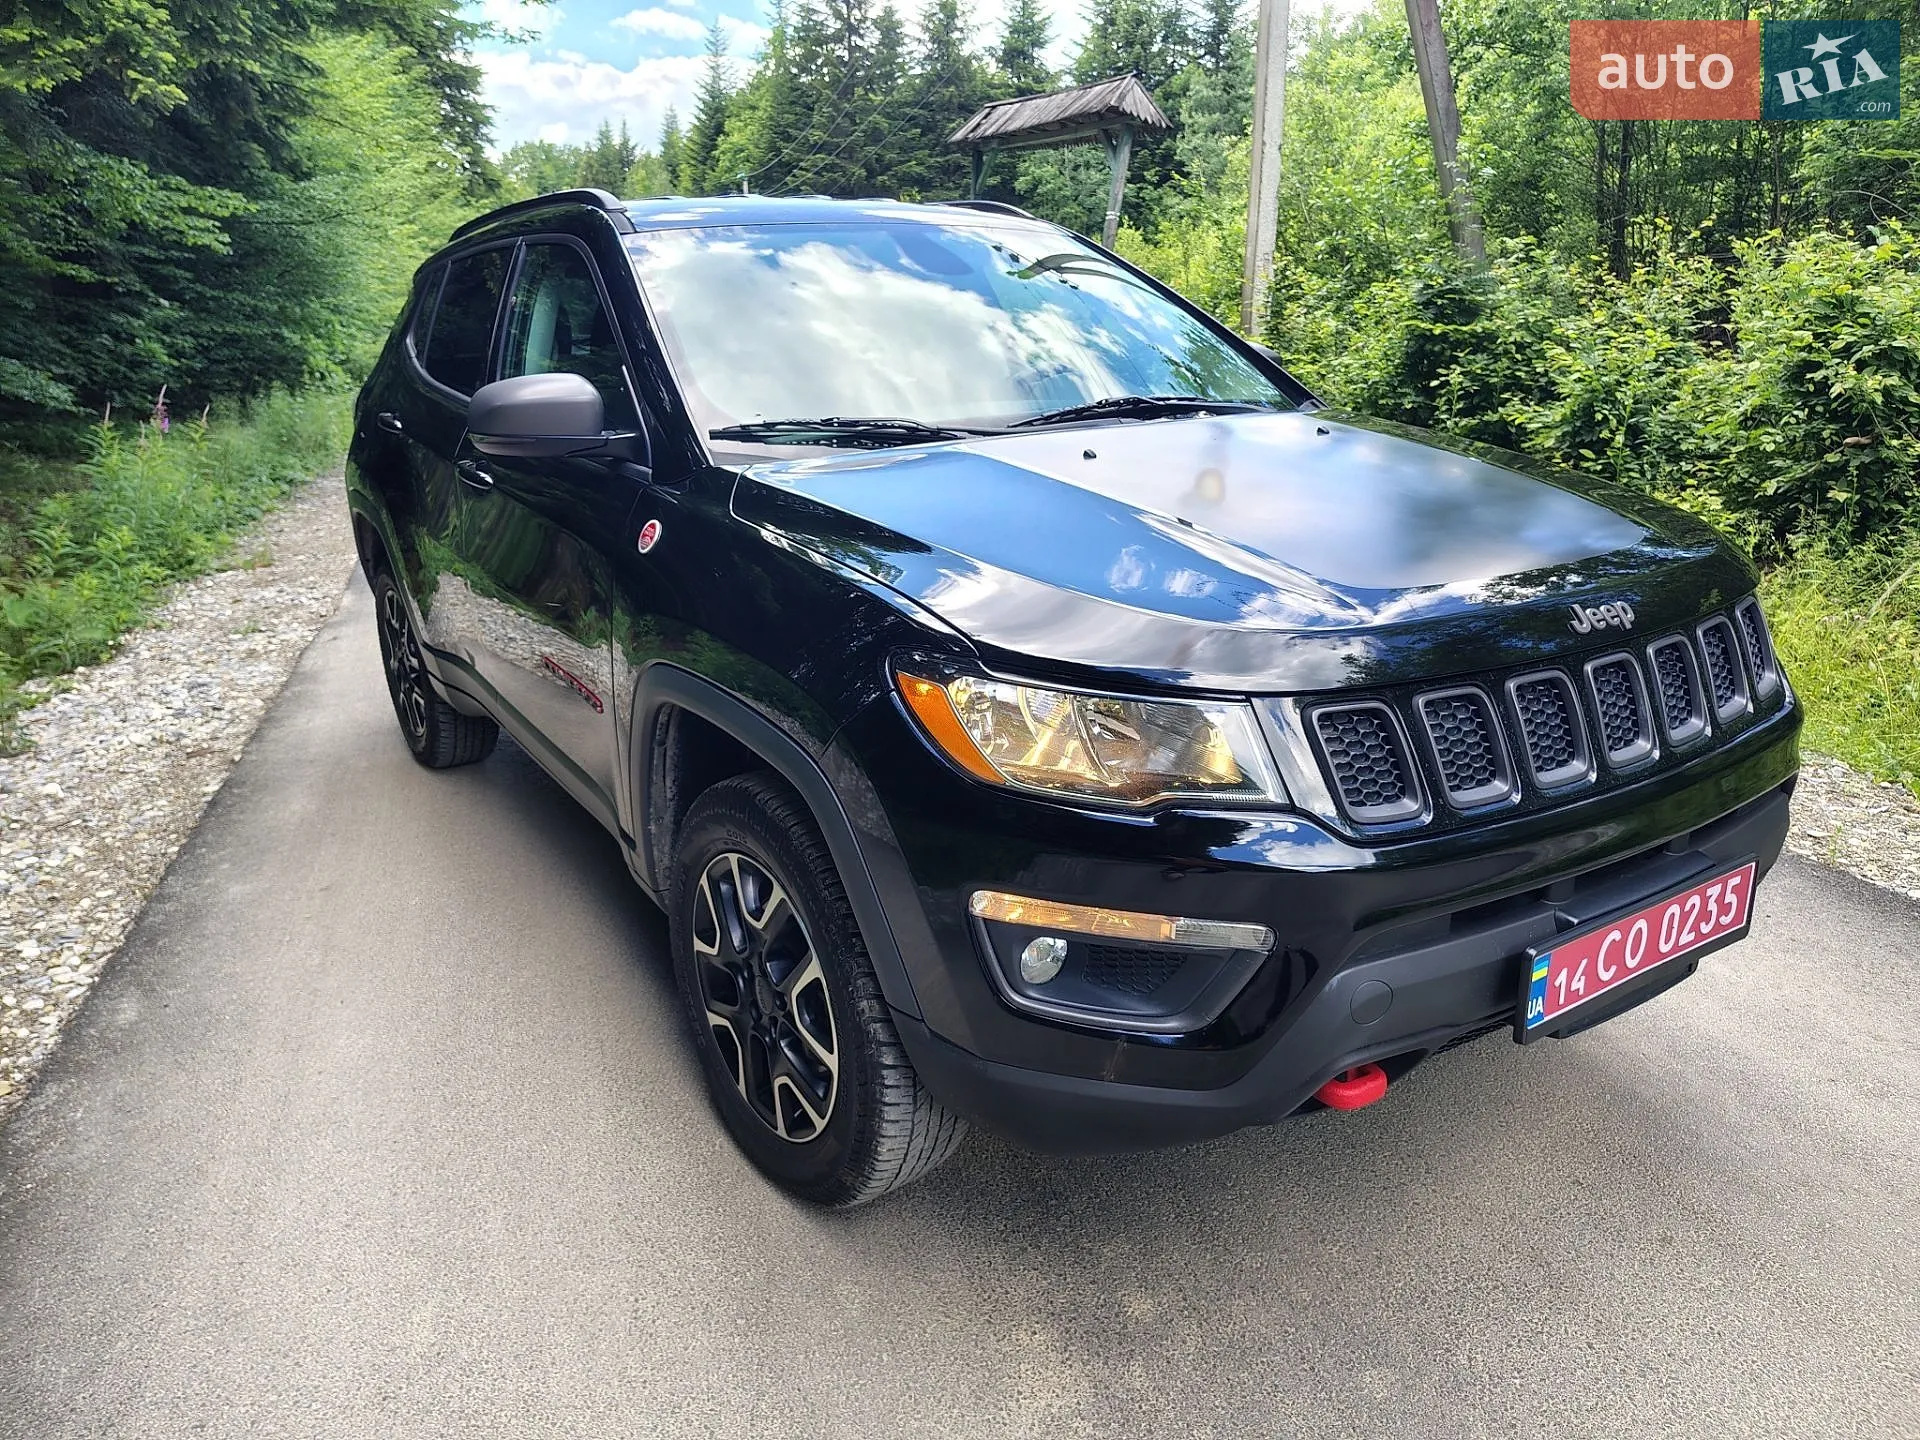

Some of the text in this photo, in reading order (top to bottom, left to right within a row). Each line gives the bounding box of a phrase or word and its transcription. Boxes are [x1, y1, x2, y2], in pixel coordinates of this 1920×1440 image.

[1567, 601, 1635, 634] Jeep
[1554, 875, 1742, 1006] 14 CO 0235
[1527, 996, 1544, 1019] UA
